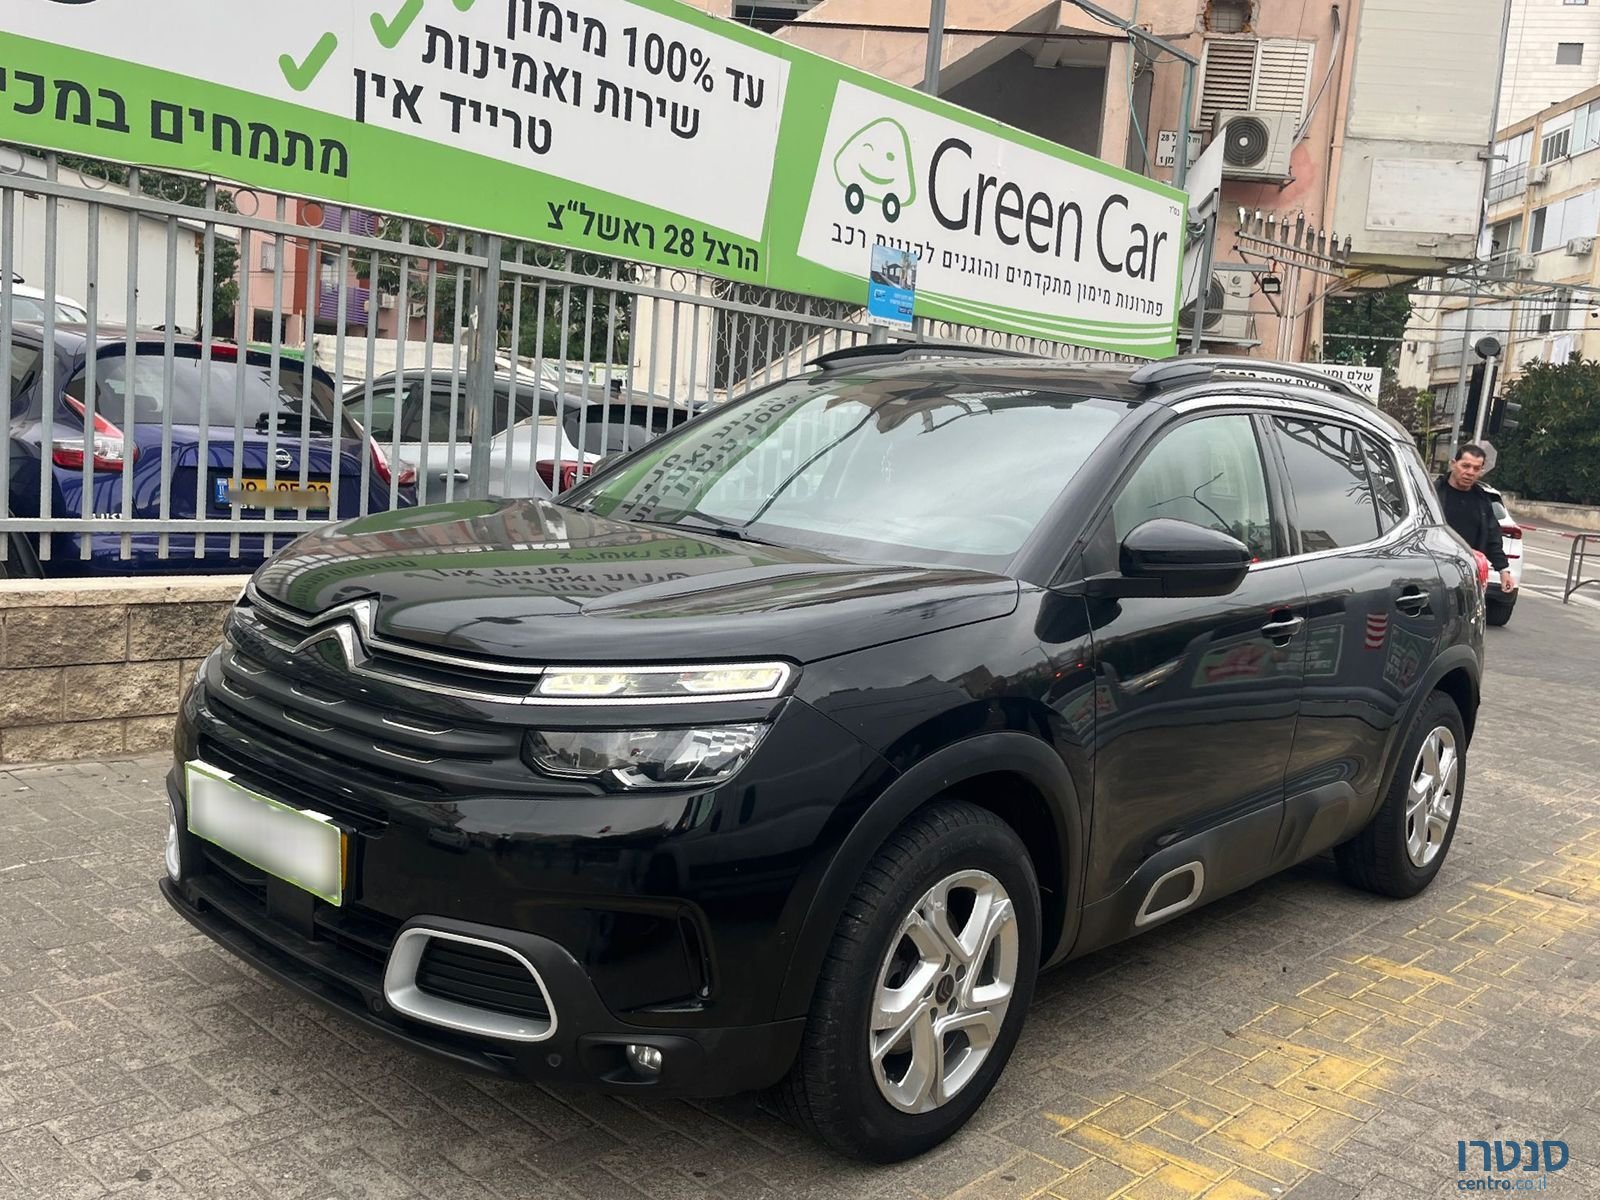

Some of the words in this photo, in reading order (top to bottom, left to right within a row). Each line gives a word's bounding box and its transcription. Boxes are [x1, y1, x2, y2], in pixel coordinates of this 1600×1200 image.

[508, 0, 606, 58] מימון
[422, 25, 581, 110] ואמינות
[624, 28, 713, 93] 100%
[353, 68, 424, 124] אין
[594, 79, 699, 139] שירות
[726, 68, 763, 108] עד
[151, 99, 348, 178] מתמחים
[440, 92, 552, 155] טרייד
[929, 137, 1082, 261] Green
[1097, 195, 1168, 281] Car
[664, 225, 694, 257] 28
[703, 232, 758, 271] הרצל
[831, 222, 866, 248] רכב
[943, 250, 1000, 280] והוגנים
[1006, 266, 1071, 296] מתקדמים
[1077, 283, 1111, 305] מימון
[1115, 292, 1163, 317] פתרונות
